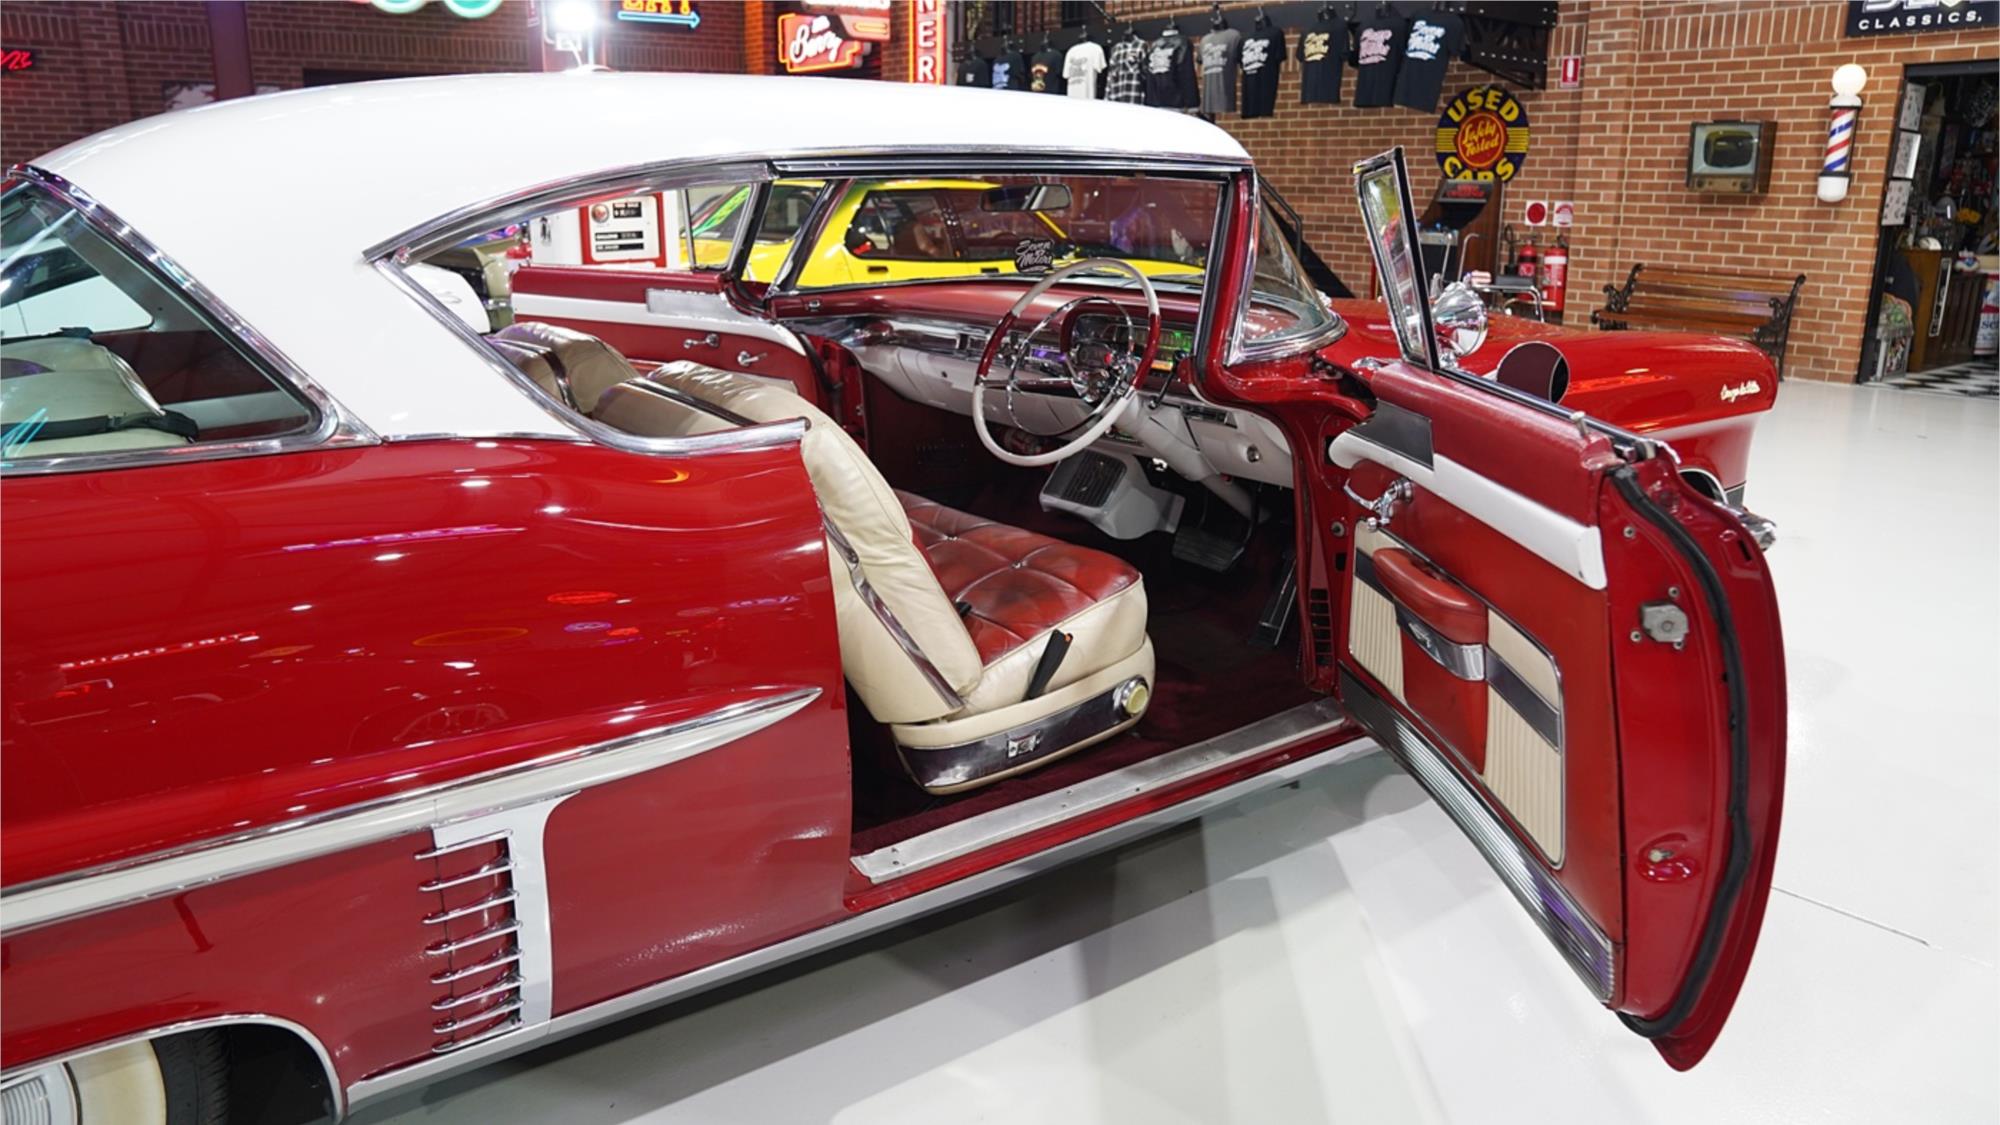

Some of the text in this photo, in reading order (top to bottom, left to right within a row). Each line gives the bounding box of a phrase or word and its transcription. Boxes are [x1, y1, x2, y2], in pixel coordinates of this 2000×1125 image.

[1447, 89, 1520, 122] USED
[1463, 120, 1498, 145] Safety
[1465, 133, 1500, 157] Tested
